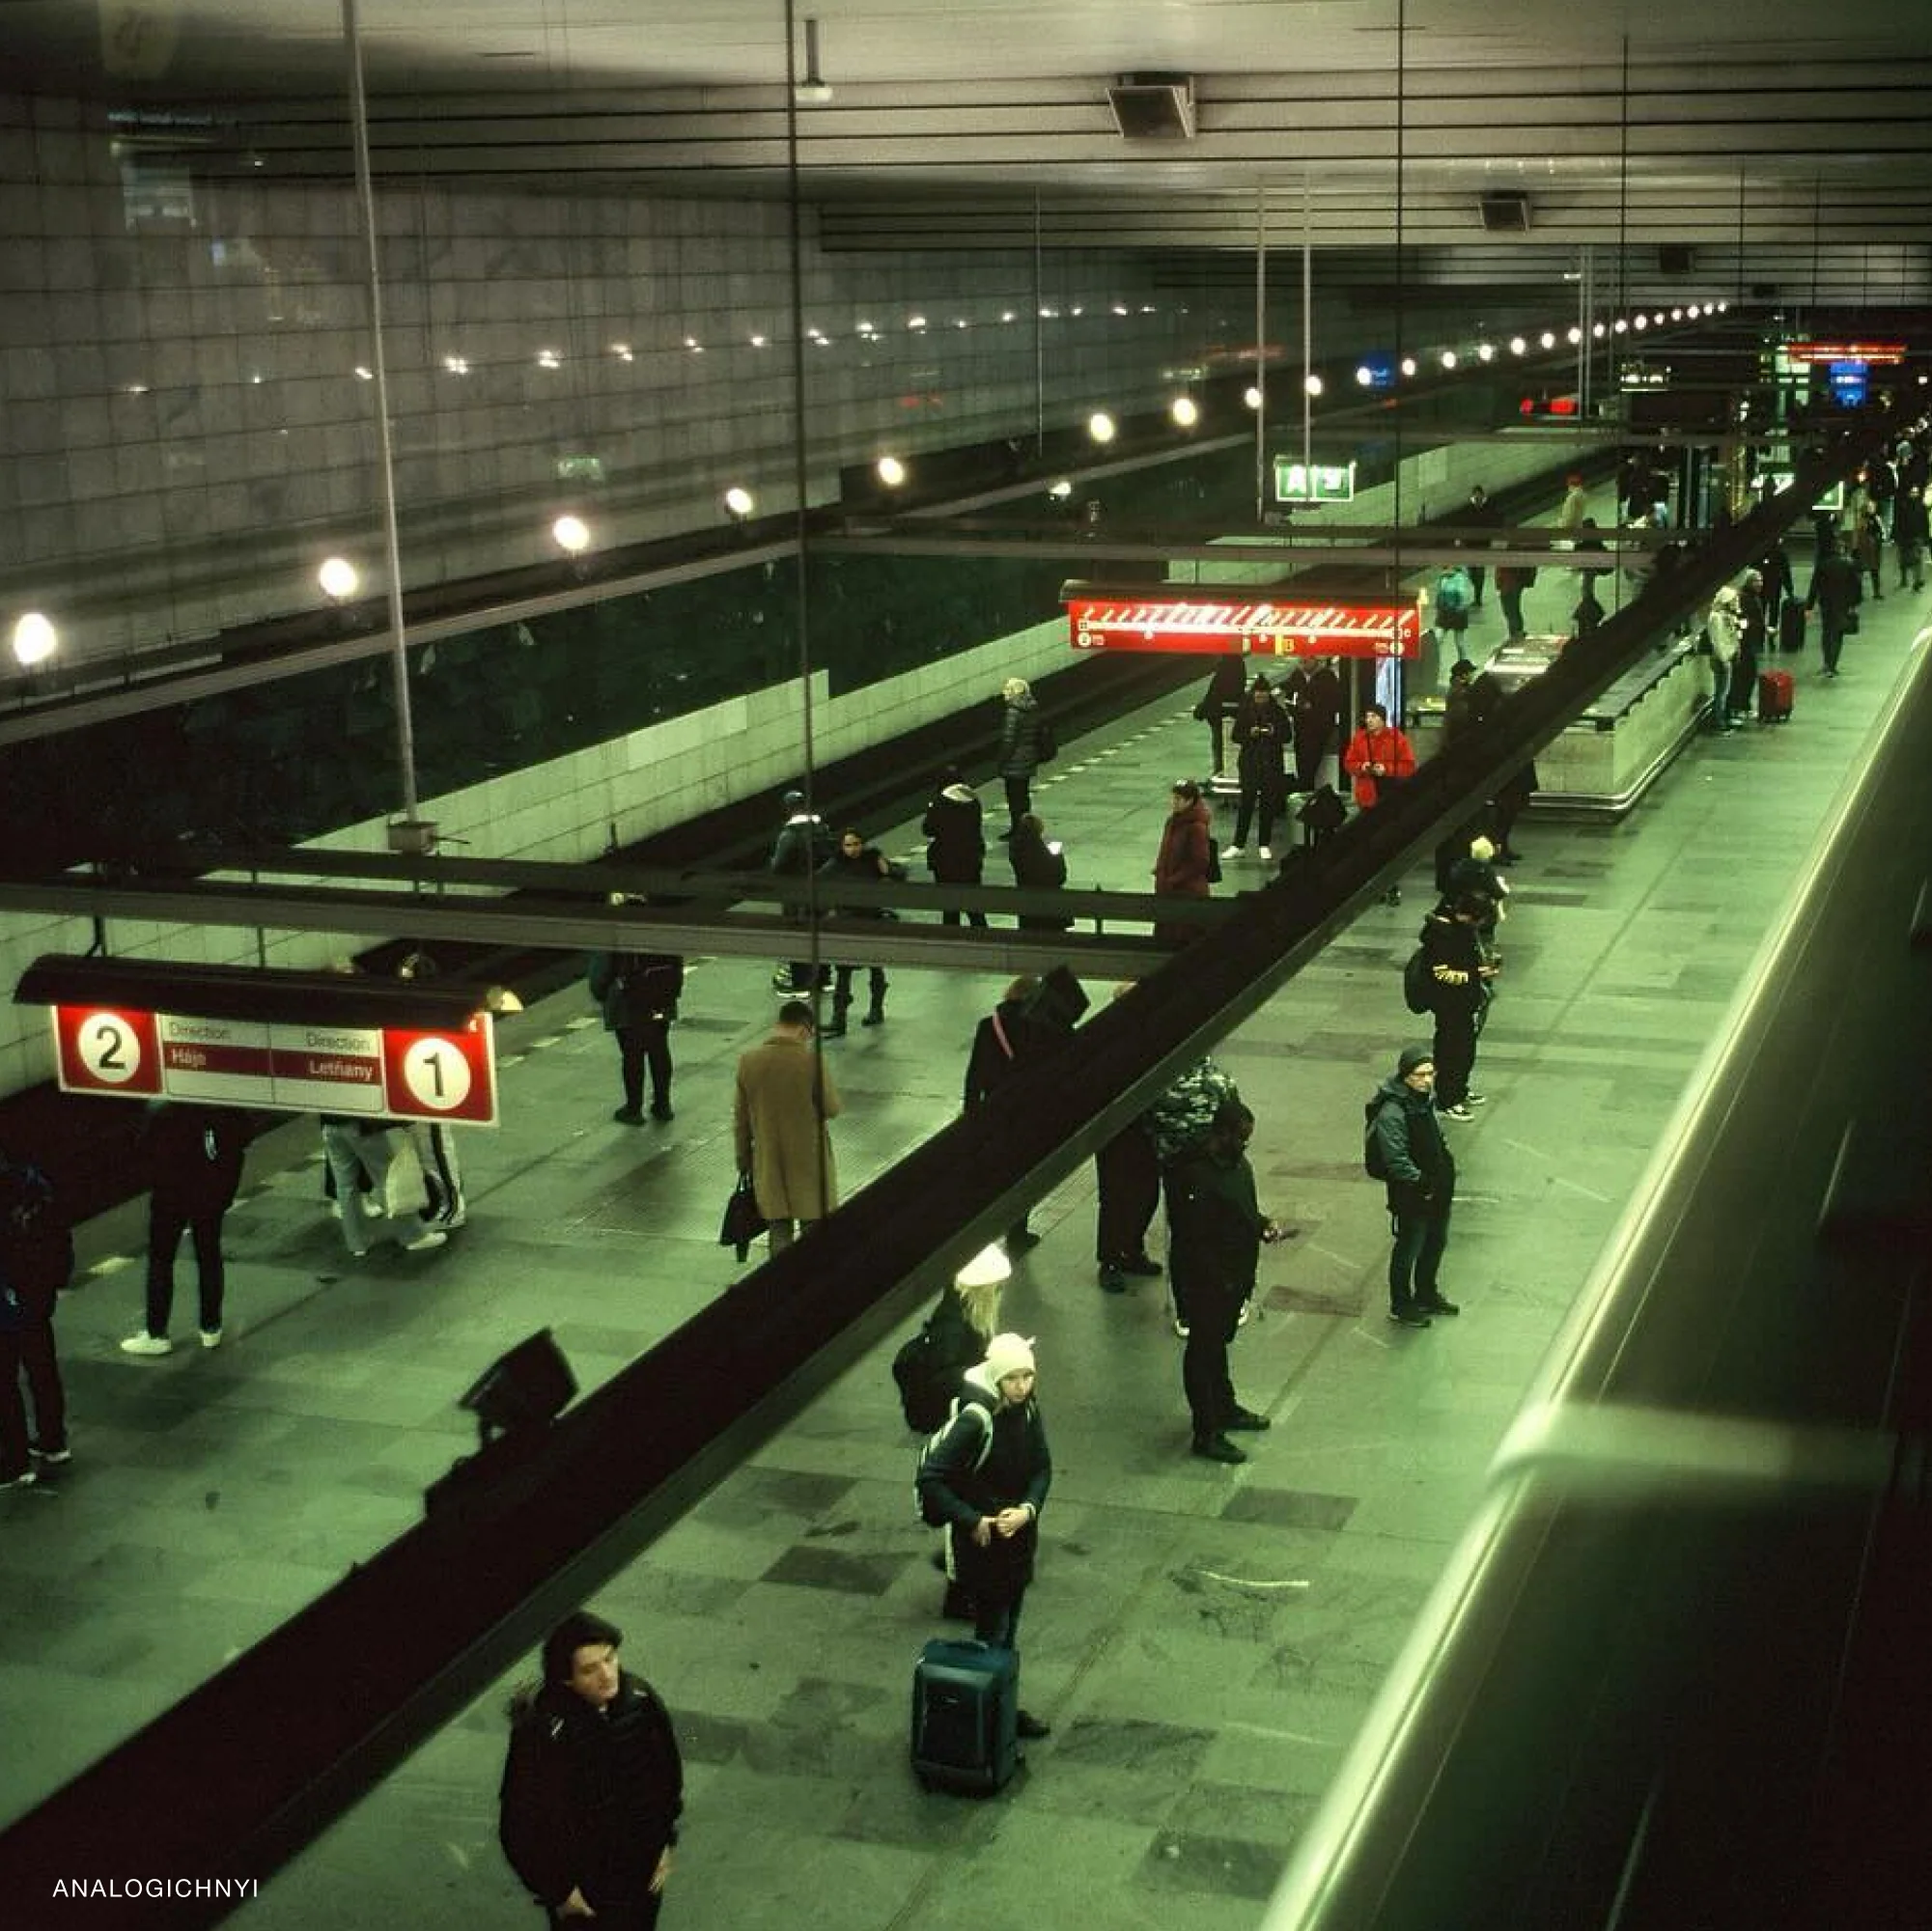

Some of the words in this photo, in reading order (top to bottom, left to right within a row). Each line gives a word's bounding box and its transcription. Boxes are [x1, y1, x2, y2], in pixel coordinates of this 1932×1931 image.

[97, 1026, 126, 1070] 2
[305, 1030, 371, 1050] Direction
[422, 1051, 444, 1097] 1
